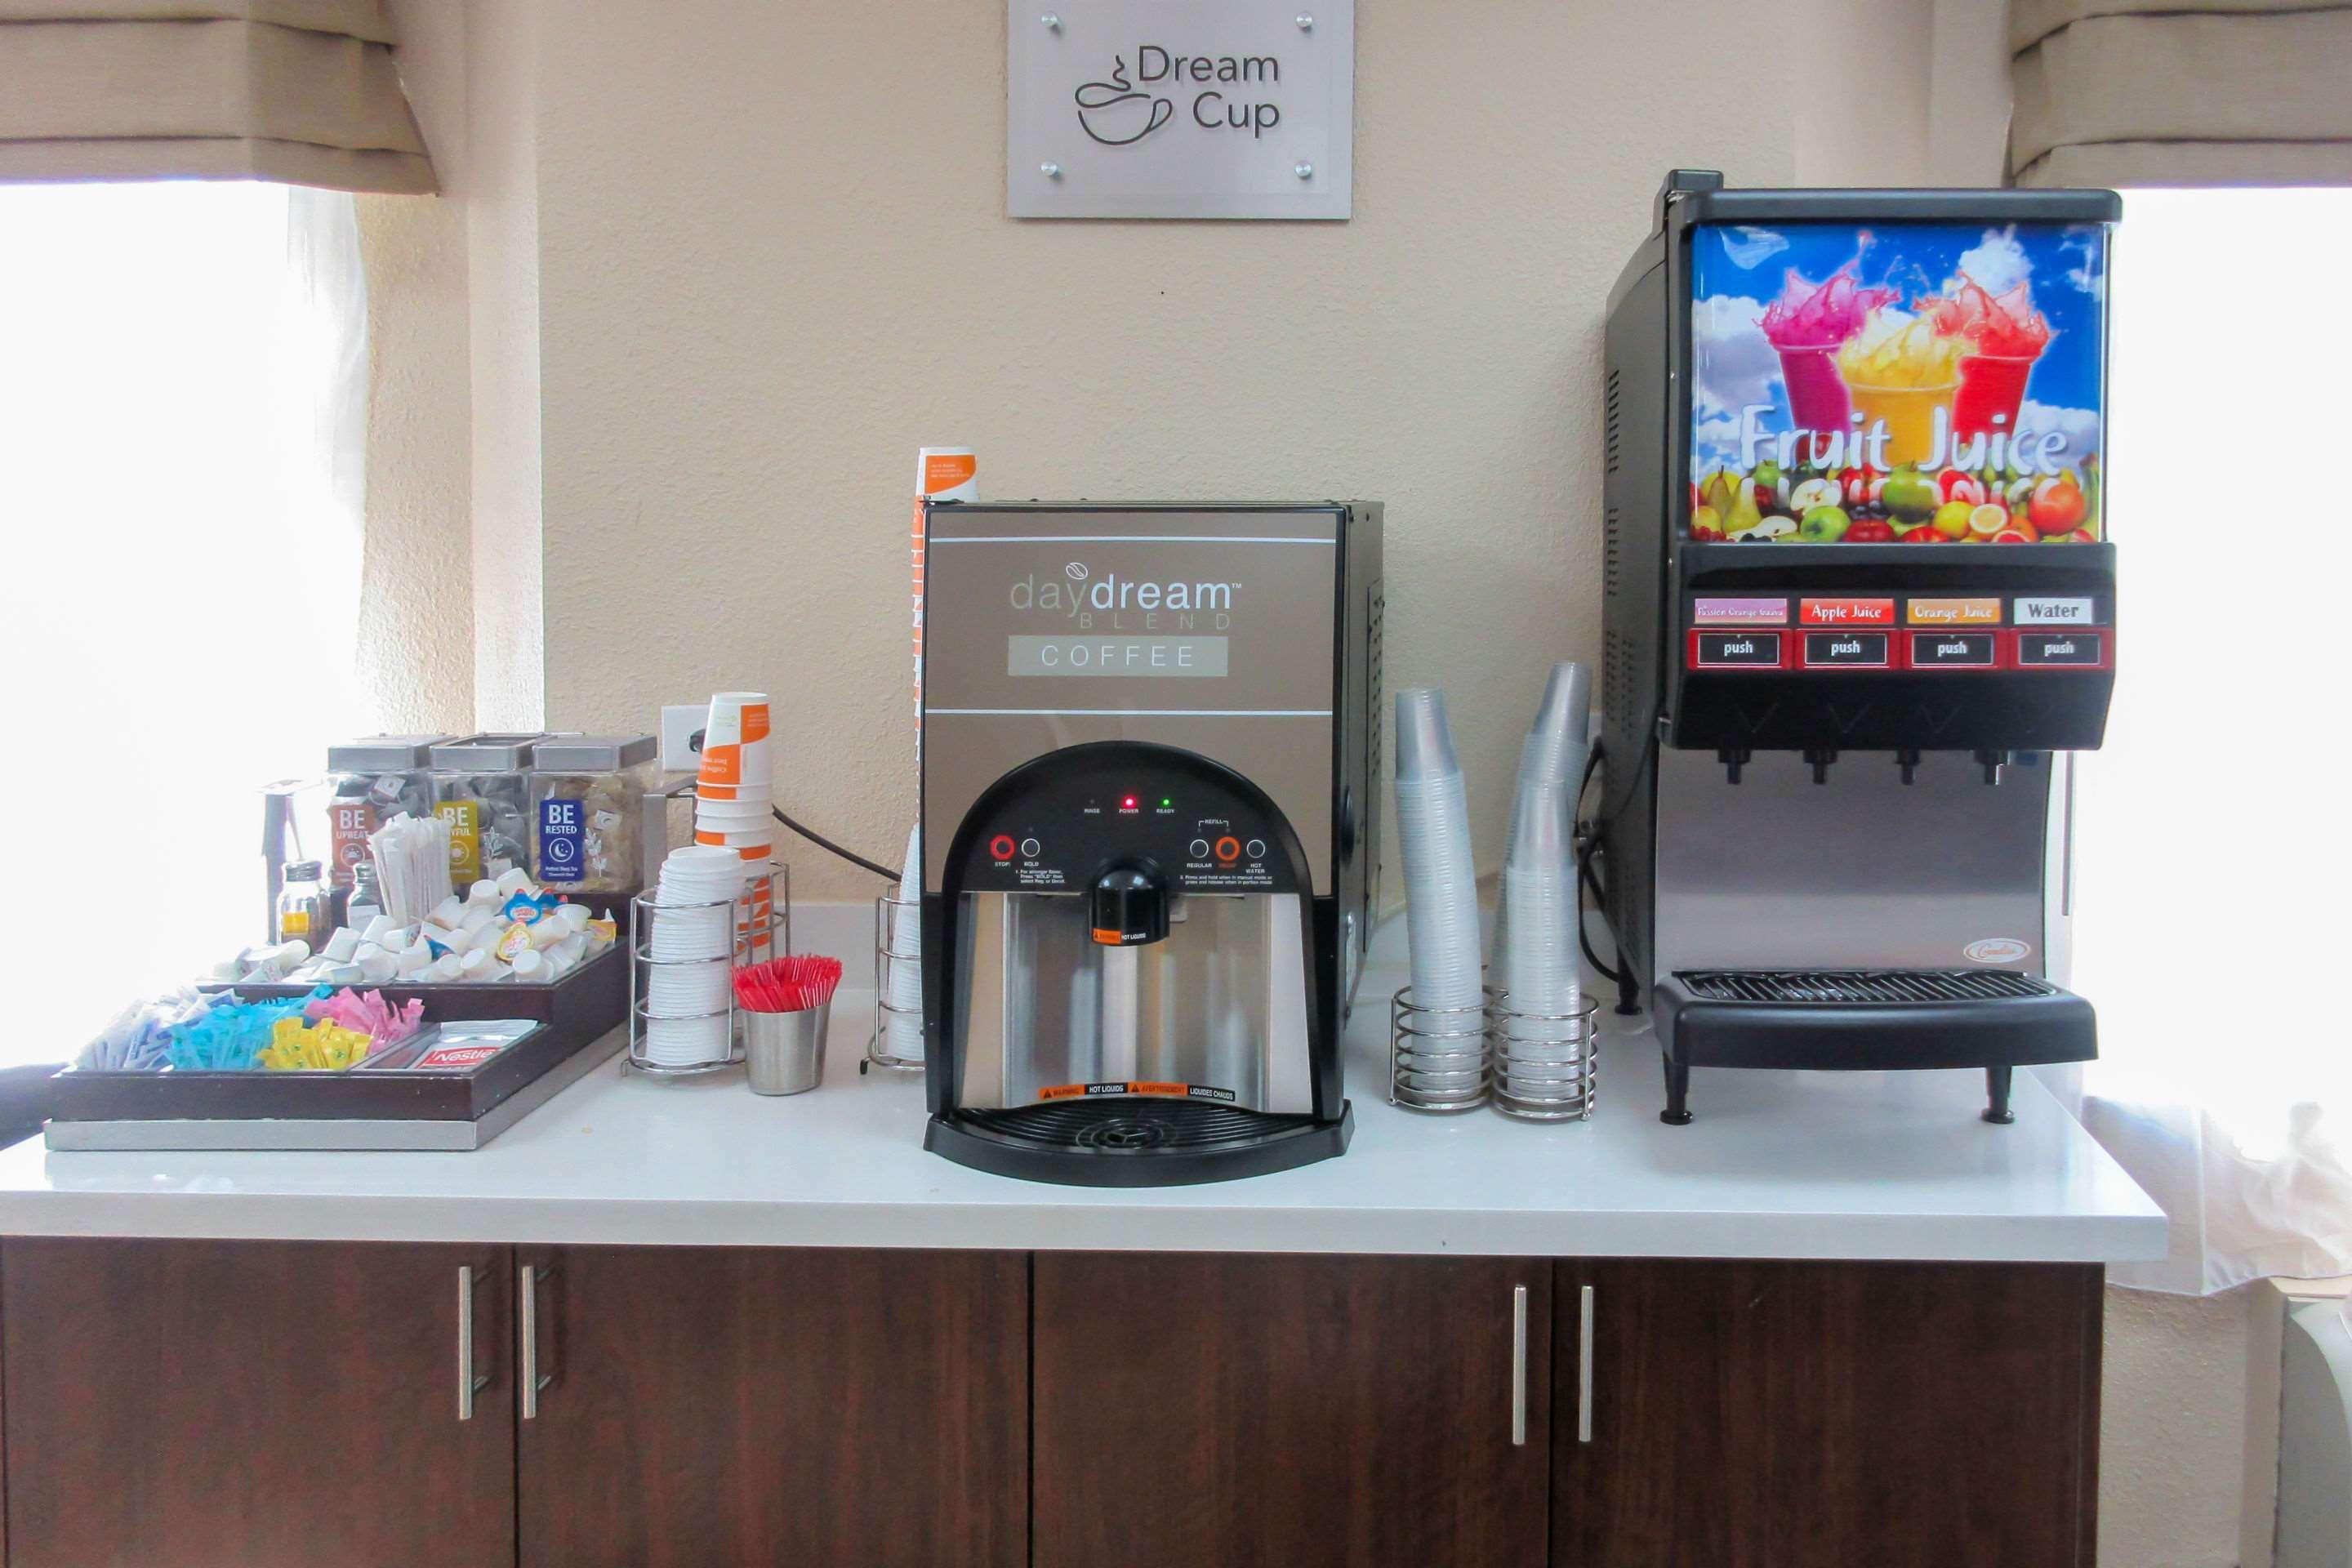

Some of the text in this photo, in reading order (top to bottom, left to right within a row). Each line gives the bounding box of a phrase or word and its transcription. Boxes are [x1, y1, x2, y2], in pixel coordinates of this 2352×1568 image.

[1138, 45, 1280, 82] Dream
[1192, 91, 1281, 139] Cup
[1740, 404, 2068, 476] Fruit Juice
[1811, 604, 1882, 621] Apple Juice
[1914, 604, 1992, 622] Orange Juice
[2027, 604, 2079, 618] Water
[1080, 612, 1230, 630] BLEND
[1041, 645, 1192, 666] COFFEE
[1724, 640, 1753, 657] push
[1831, 640, 1861, 657] push
[1937, 640, 1967, 657] push
[2044, 640, 2075, 657] push
[340, 809, 365, 830] BE
[443, 806, 468, 826] BE
[549, 804, 575, 824] BE
[336, 831, 368, 840] UPBEAT
[546, 826, 577, 834] RESTED
[1102, 1085, 1124, 1093] LIQUIDS
